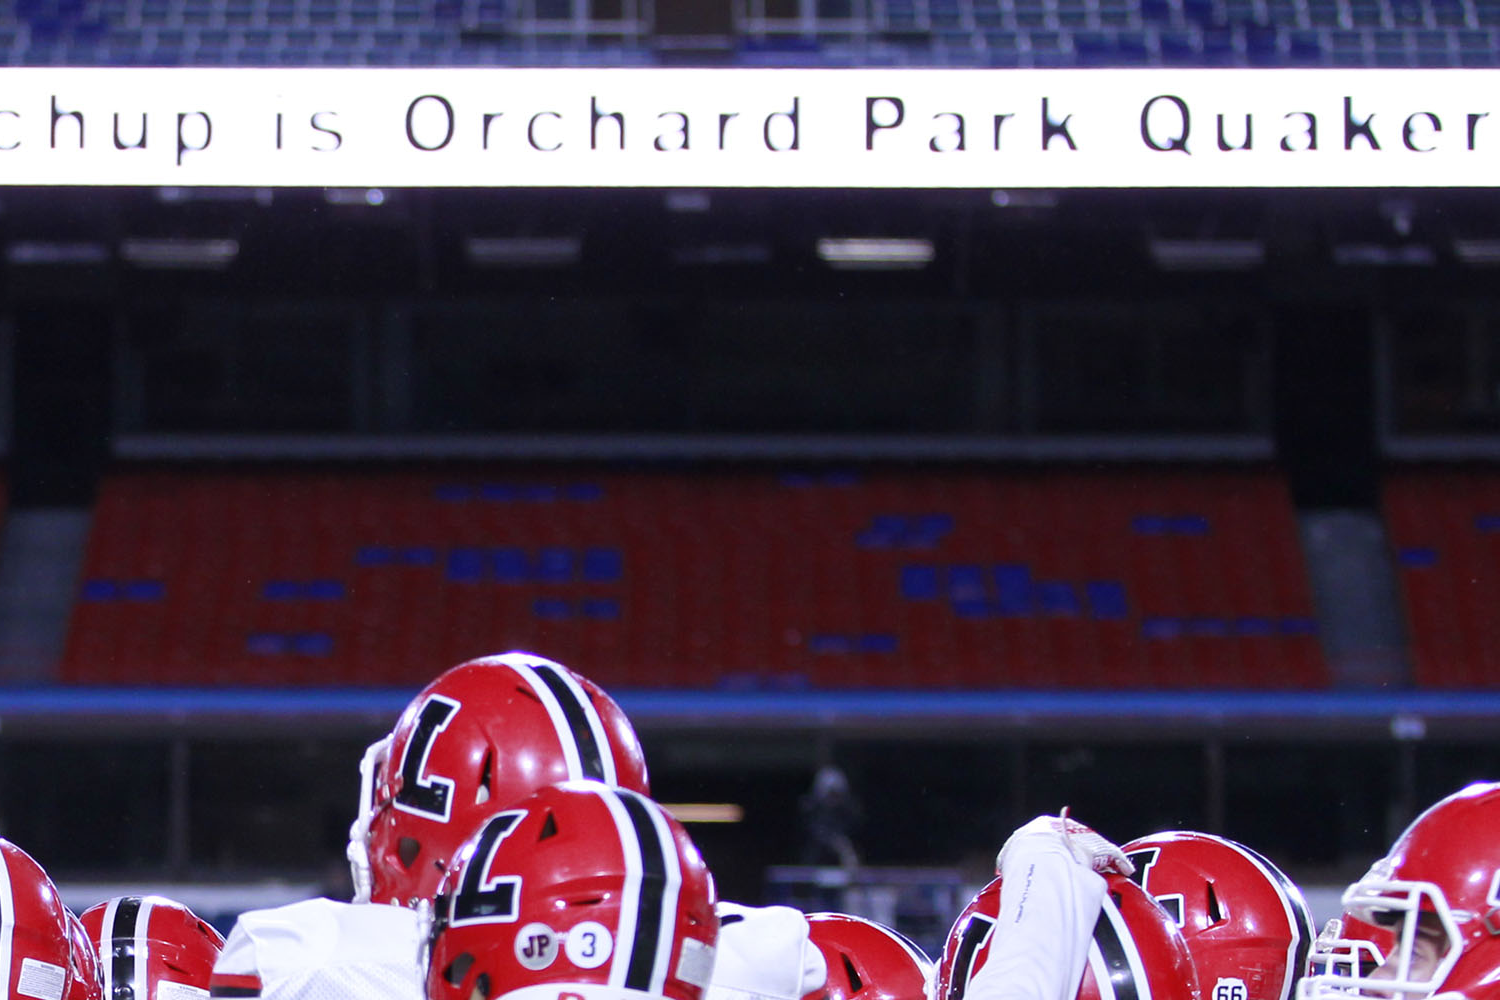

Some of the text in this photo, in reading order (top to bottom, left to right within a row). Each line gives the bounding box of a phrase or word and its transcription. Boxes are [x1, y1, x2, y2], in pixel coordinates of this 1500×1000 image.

[275, 94, 343, 152] is
[404, 94, 800, 153] Orchard
[865, 96, 1079, 152] Park
[1139, 94, 1490, 157] Quaker
[393, 693, 461, 823] L
[449, 809, 528, 927] L
[522, 932, 596, 960] JP 3
